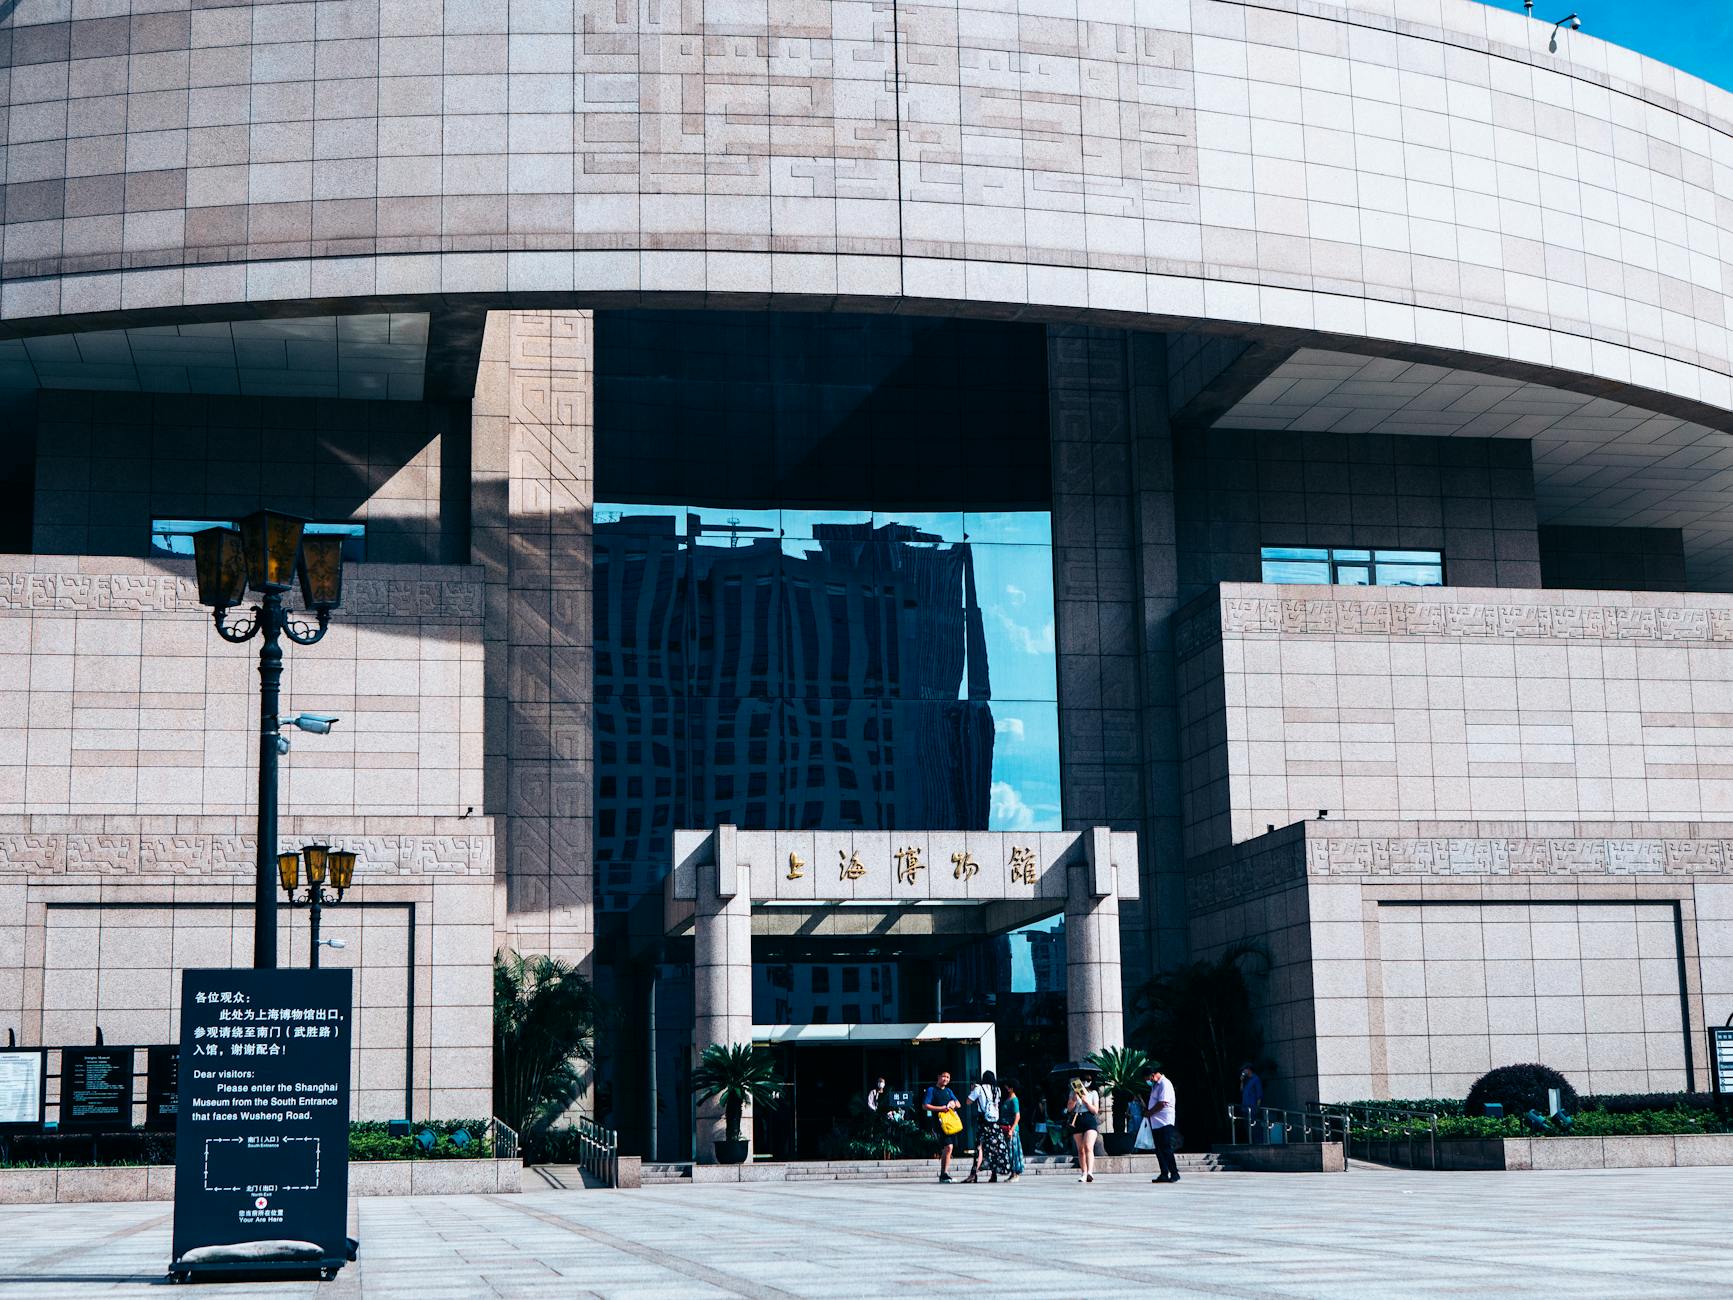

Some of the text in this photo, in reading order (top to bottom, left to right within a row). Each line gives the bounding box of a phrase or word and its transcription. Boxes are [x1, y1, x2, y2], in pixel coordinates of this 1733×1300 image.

[786, 845, 1041, 886] 上海博物館
[195, 991, 251, 1004] 各位观众：
[219, 1008, 344, 1021] 此处为上海博物馆出口，
[193, 1069, 255, 1079] Dear visitors:
[217, 1083, 338, 1094] Please enter the Shanghai
[192, 1097, 338, 1107] Museum from the South Entrance
[192, 1111, 313, 1122] that faces Wusheng Road.
